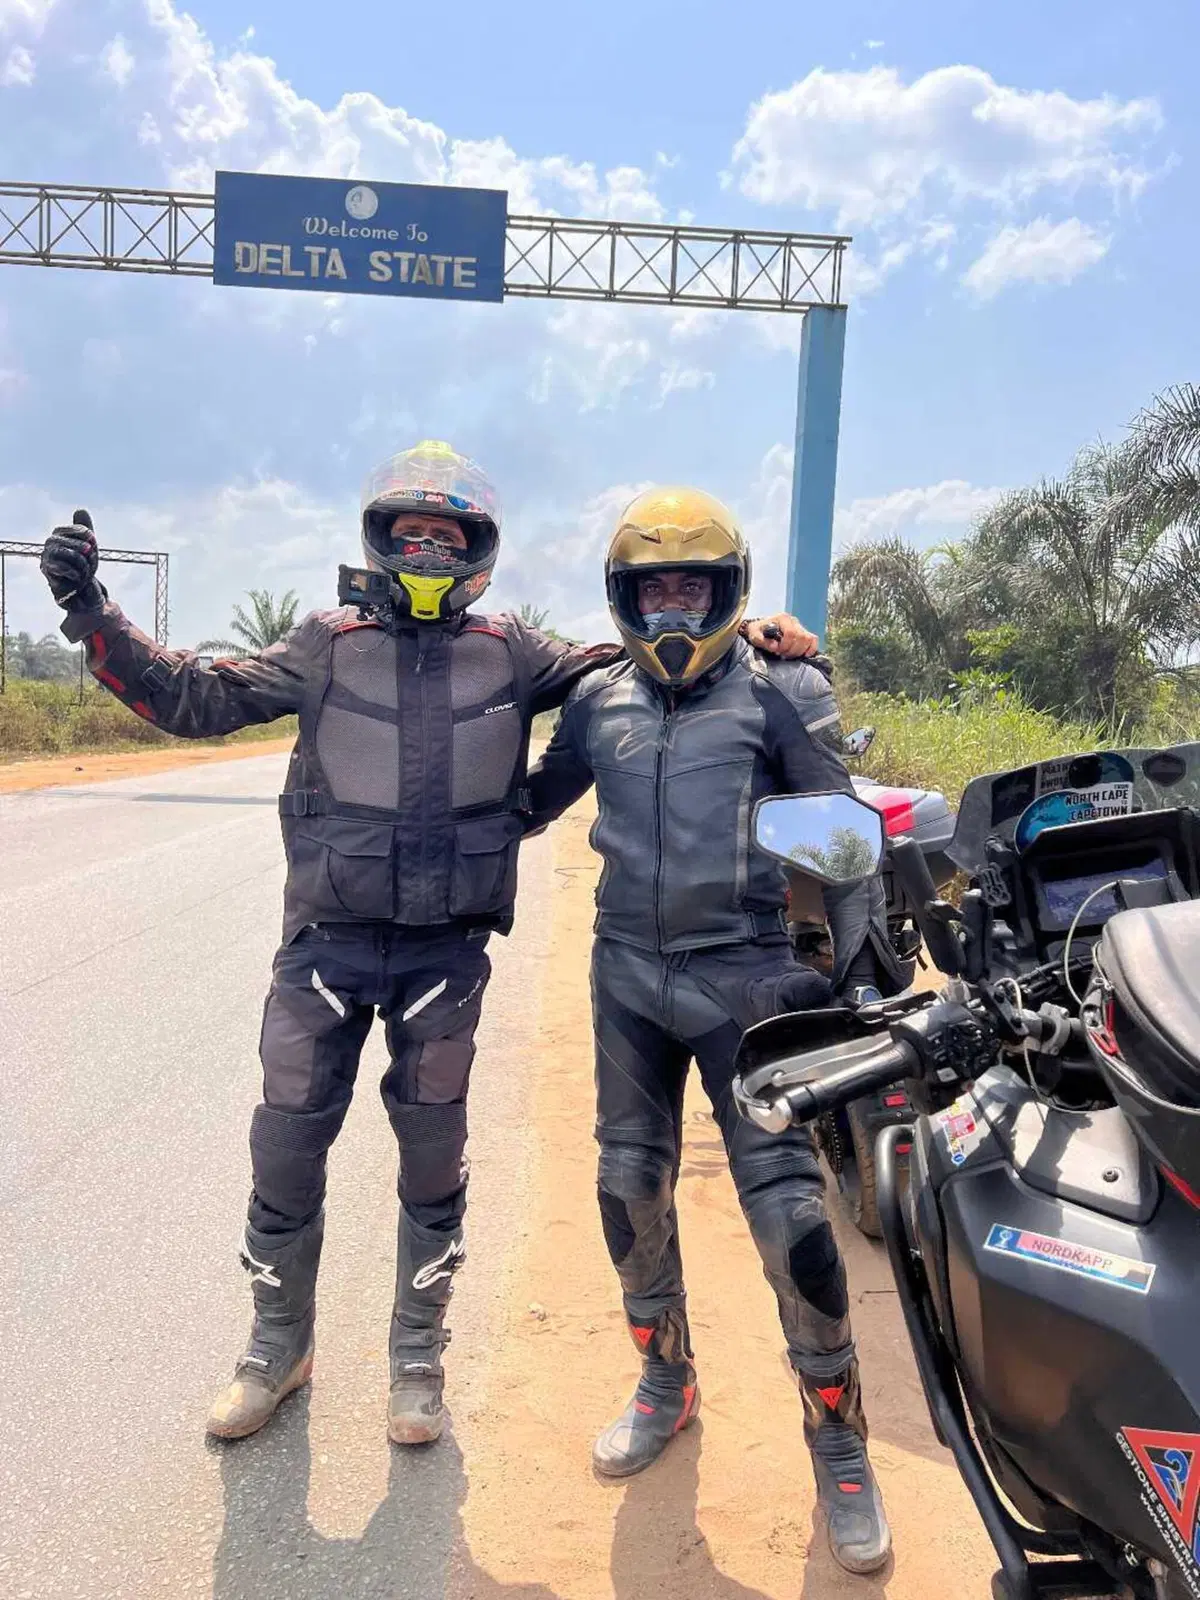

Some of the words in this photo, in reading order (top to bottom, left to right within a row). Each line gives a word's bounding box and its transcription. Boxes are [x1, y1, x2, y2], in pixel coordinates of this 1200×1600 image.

[303, 216, 399, 241] Welcome
[406, 223, 428, 242] To
[234, 240, 347, 280] DELTA
[368, 250, 477, 288] STATE
[420, 543, 452, 556] YouTube
[1065, 791, 1100, 806] NORTH
[1102, 789, 1129, 801] CAPE
[1071, 805, 1129, 821] CAPETOWN
[1031, 1239, 1113, 1269] NORDKAPP
[1115, 1431, 1161, 1503] GESTIONE
[1156, 1503, 1194, 1565] SINISTRI
